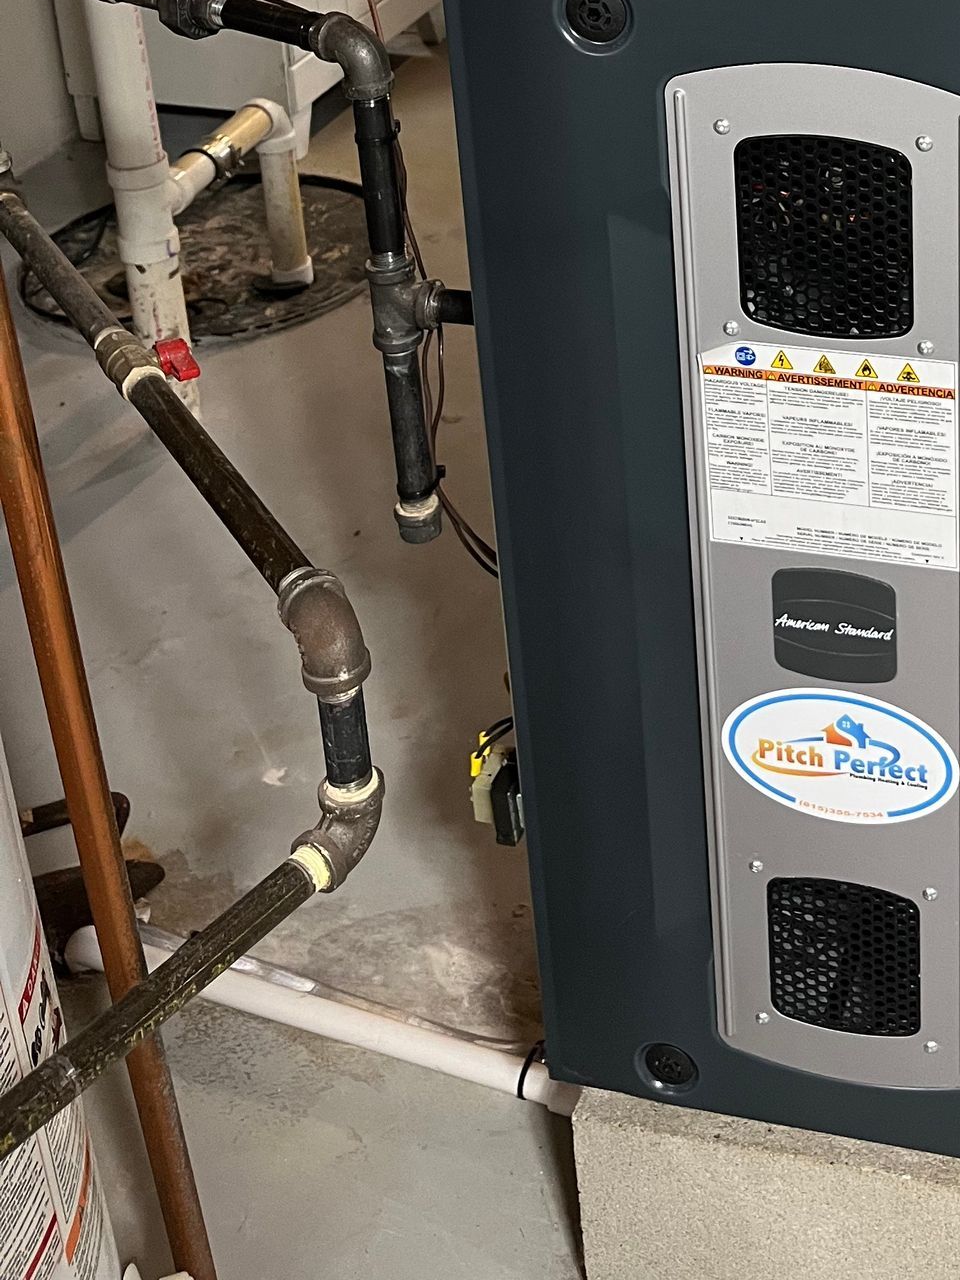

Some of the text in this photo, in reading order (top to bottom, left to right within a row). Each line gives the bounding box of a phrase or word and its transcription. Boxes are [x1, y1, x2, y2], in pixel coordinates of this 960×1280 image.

[714, 366, 954, 399] WARNING AVERTISSEMENT ADVERTENCIA
[774, 613, 894, 641] American Standard
[758, 738, 928, 784] Pitch Perfect
[850, 773, 876, 782] Plumbing
